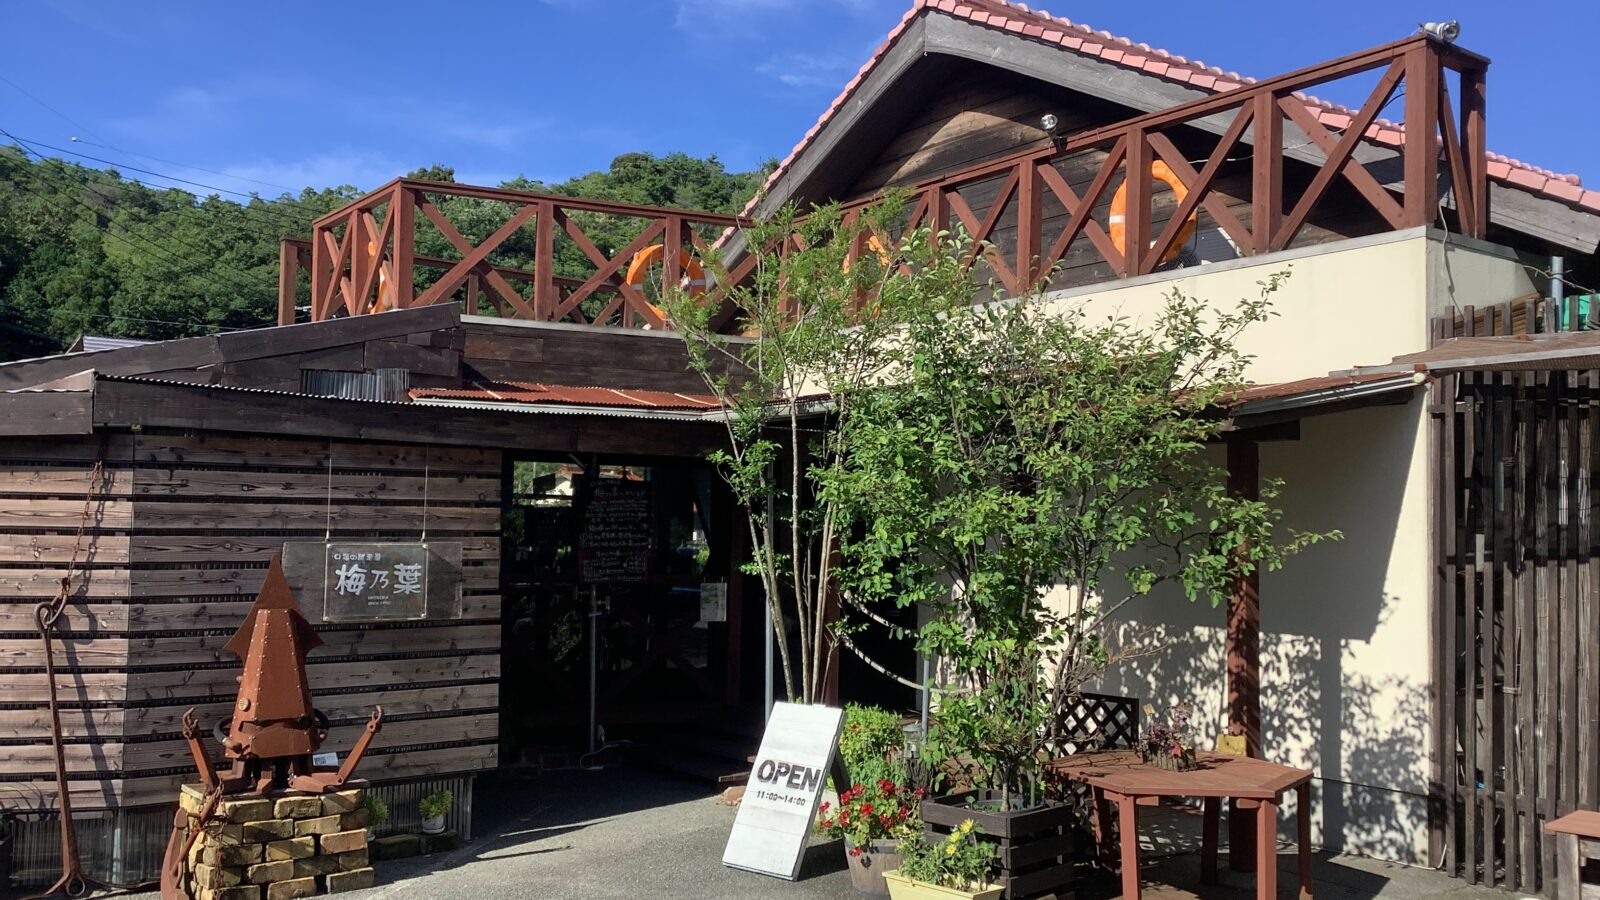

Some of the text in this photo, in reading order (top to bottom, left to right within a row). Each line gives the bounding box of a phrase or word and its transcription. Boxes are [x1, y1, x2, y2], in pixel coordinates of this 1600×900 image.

[334, 562, 422, 596] 梅乃葉
[757, 759, 822, 792] OPEN
